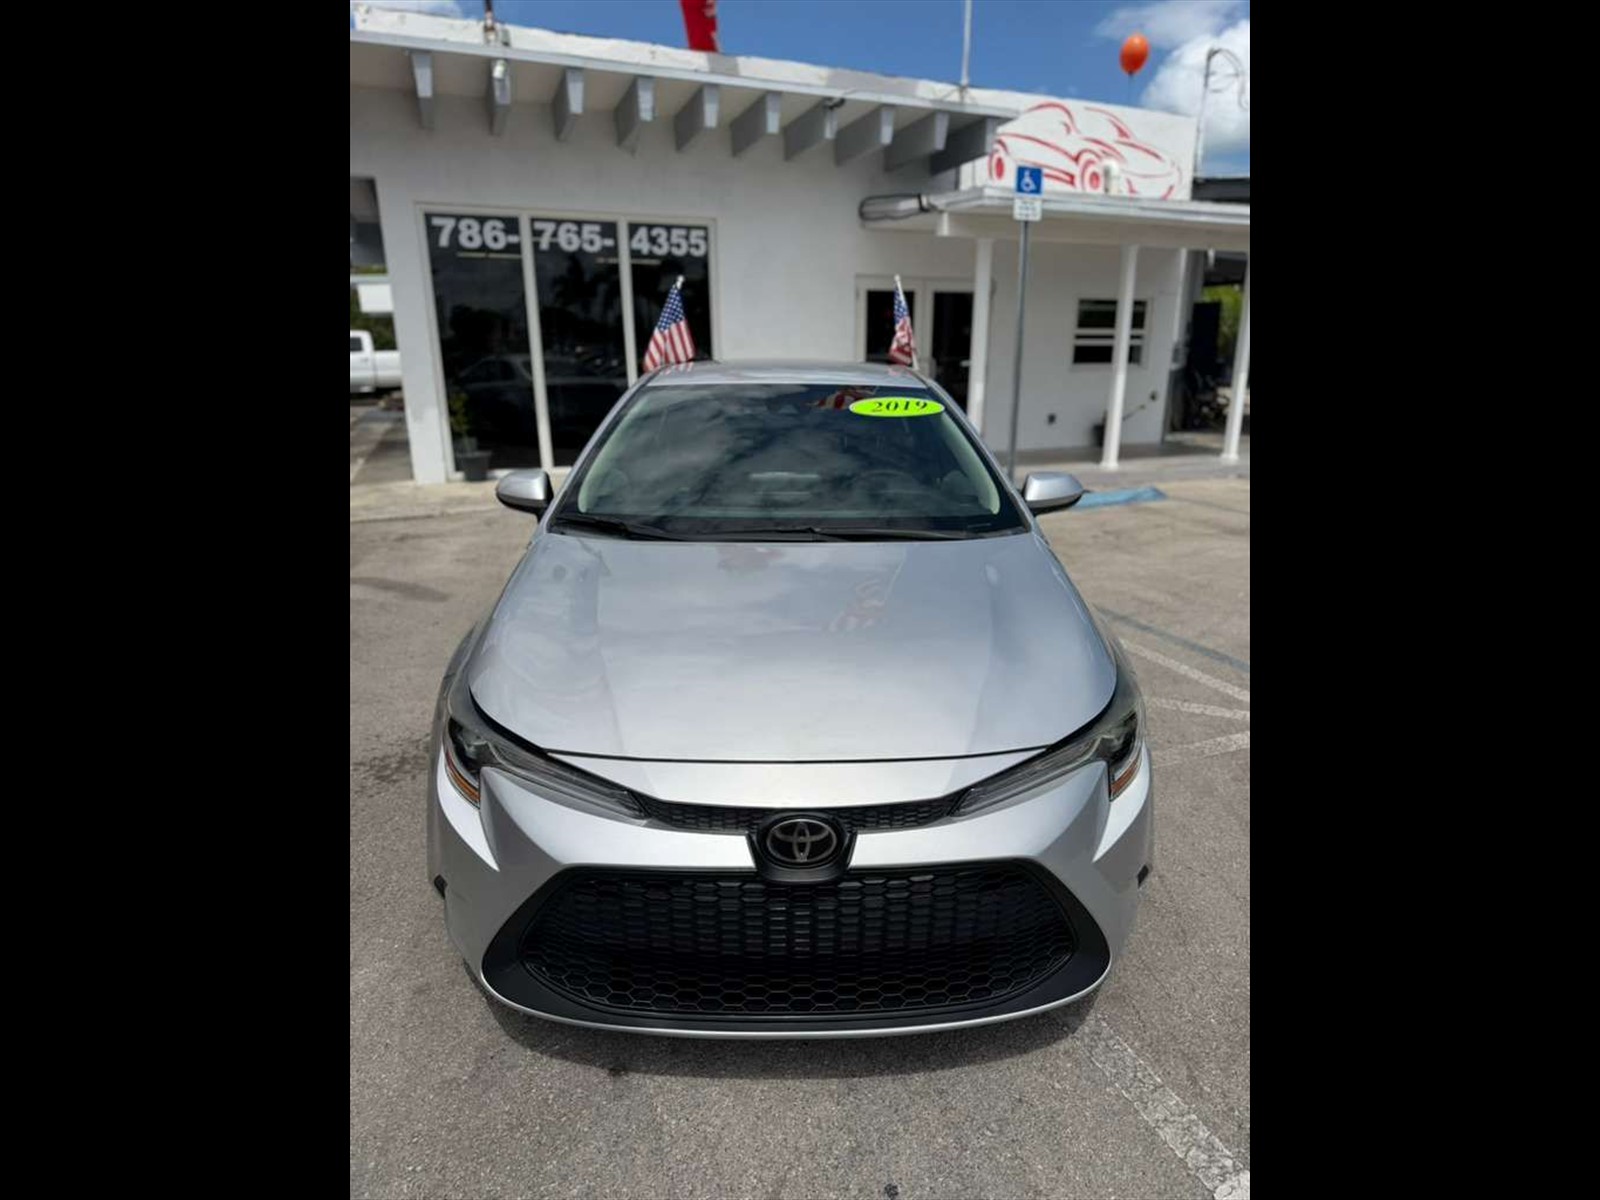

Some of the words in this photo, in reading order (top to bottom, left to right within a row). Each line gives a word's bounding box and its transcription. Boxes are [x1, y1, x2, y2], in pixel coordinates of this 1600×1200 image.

[430, 216, 520, 249] 786-
[532, 220, 615, 253] 765-
[630, 226, 707, 257] 4355
[871, 400, 928, 413] 2019
